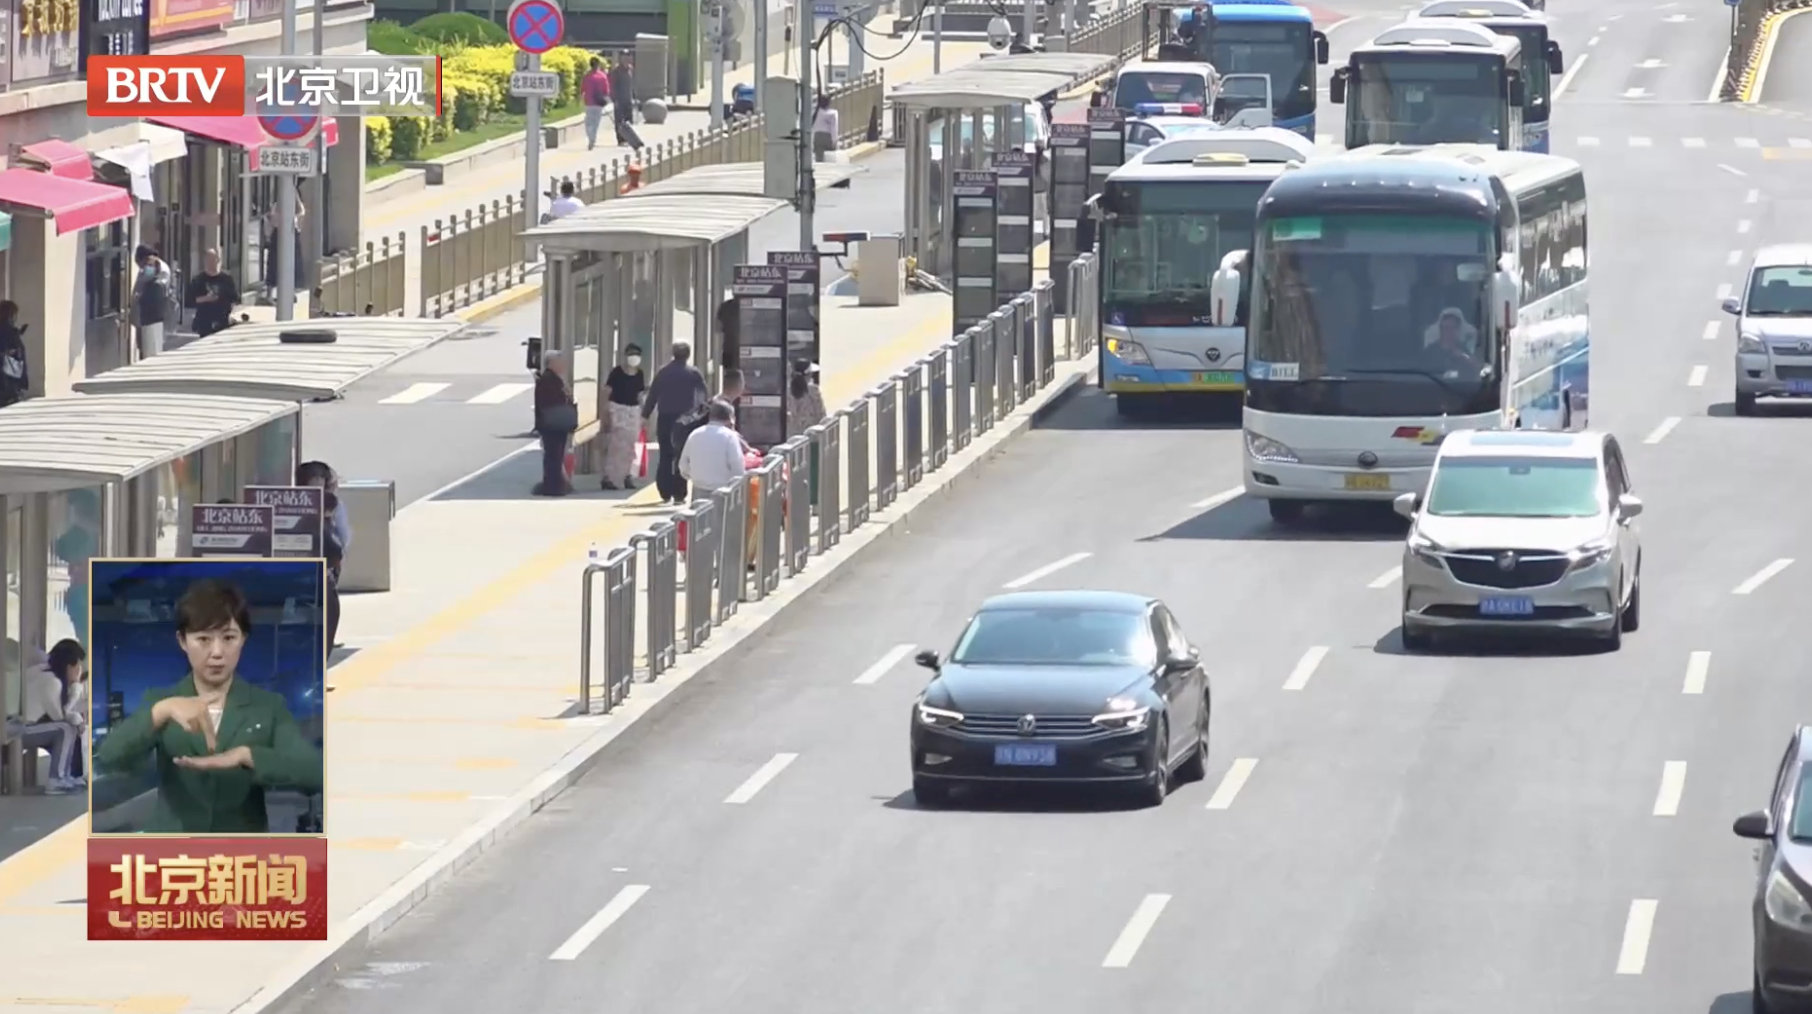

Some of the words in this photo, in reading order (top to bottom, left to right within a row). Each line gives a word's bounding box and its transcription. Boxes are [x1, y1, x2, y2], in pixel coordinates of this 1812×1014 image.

[513, 76, 554, 90] 北京站东街
[260, 150, 309, 167] 北京站东街
[255, 490, 313, 506] 北京站东
[202, 508, 263, 524] 北京站东
